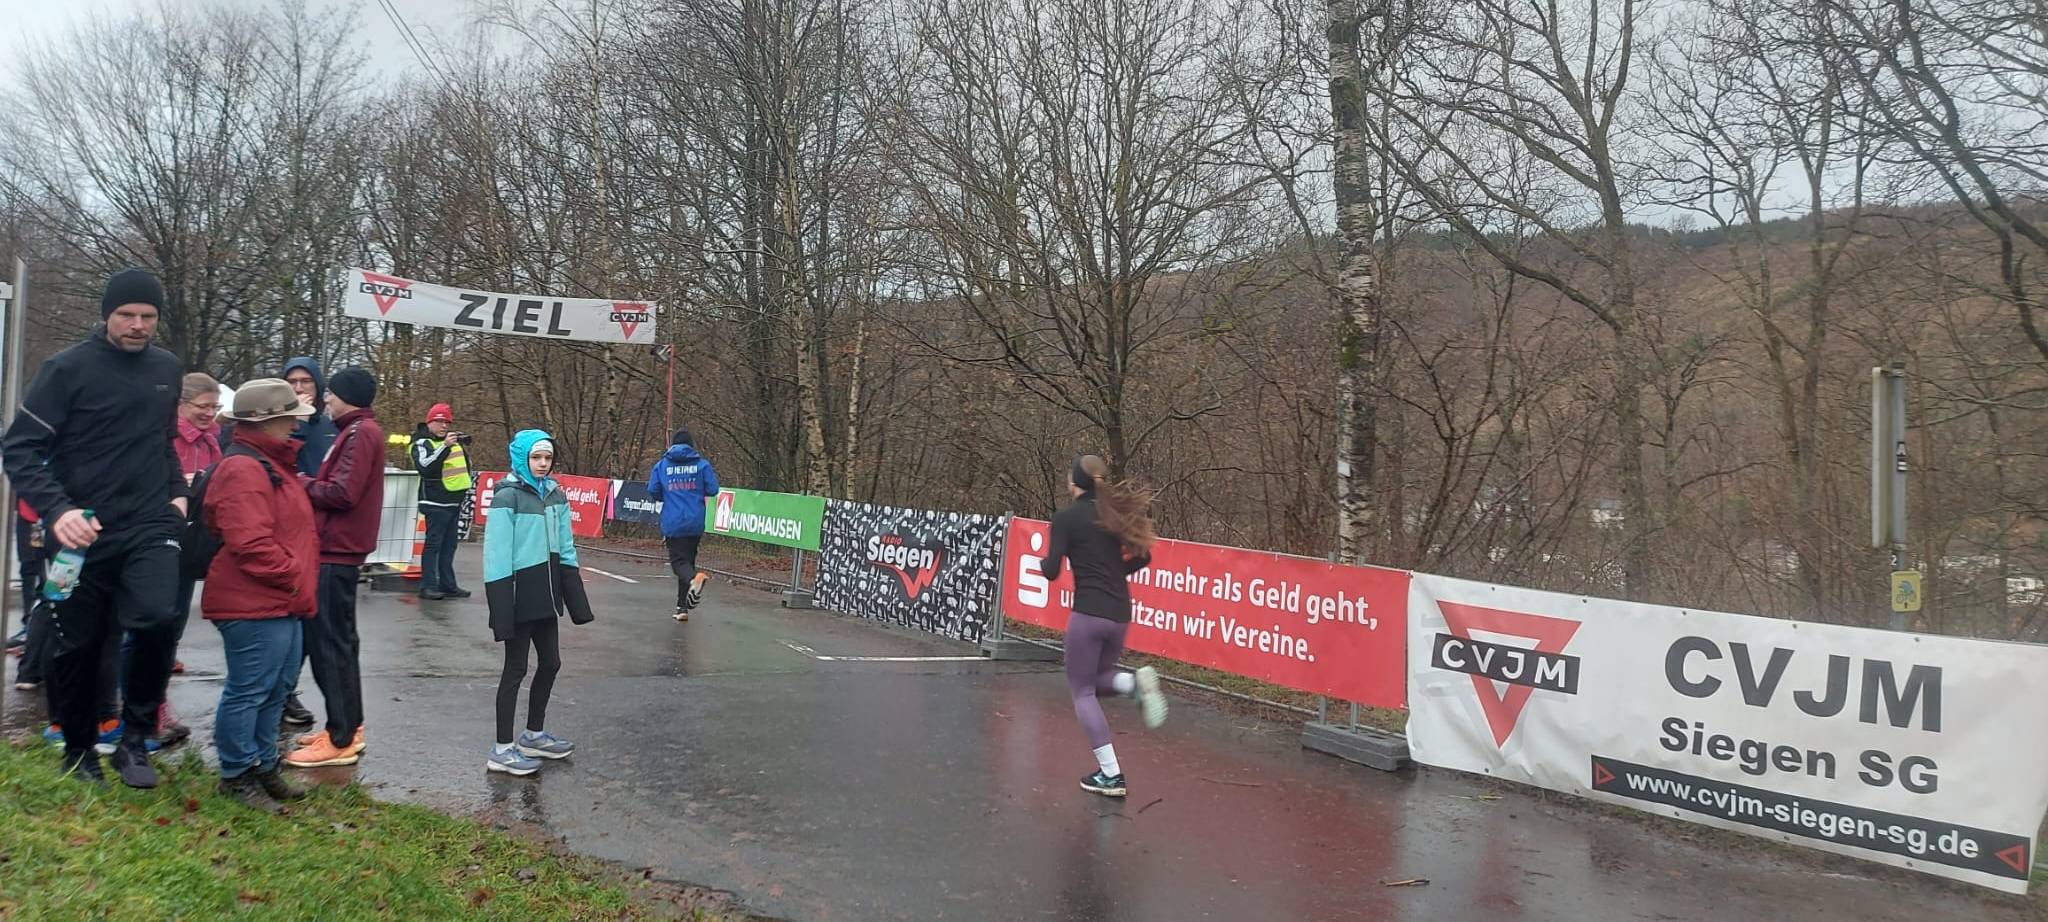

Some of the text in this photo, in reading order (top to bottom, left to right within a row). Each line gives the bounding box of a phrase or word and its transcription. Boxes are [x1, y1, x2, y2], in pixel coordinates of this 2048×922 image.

[361, 284, 411, 298] CVJM
[454, 293, 571, 336] ZIEL
[611, 312, 648, 322] CVJM
[729, 512, 801, 541] HUNDHAUSEN
[866, 535, 934, 570] Siegen
[1155, 566, 1208, 597] mehr
[1211, 578, 1242, 603] als
[1248, 578, 1301, 614] Geld
[1305, 593, 1378, 631] geht,
[1183, 612, 1216, 640] wir
[1219, 615, 1315, 663] Vereine.
[1440, 639, 1567, 688] CVJM
[1665, 636, 1942, 733] CVJM
[1659, 716, 1938, 794] Siegen SG
[1626, 771, 1980, 858] www.cvjm-siegen-sg.de
